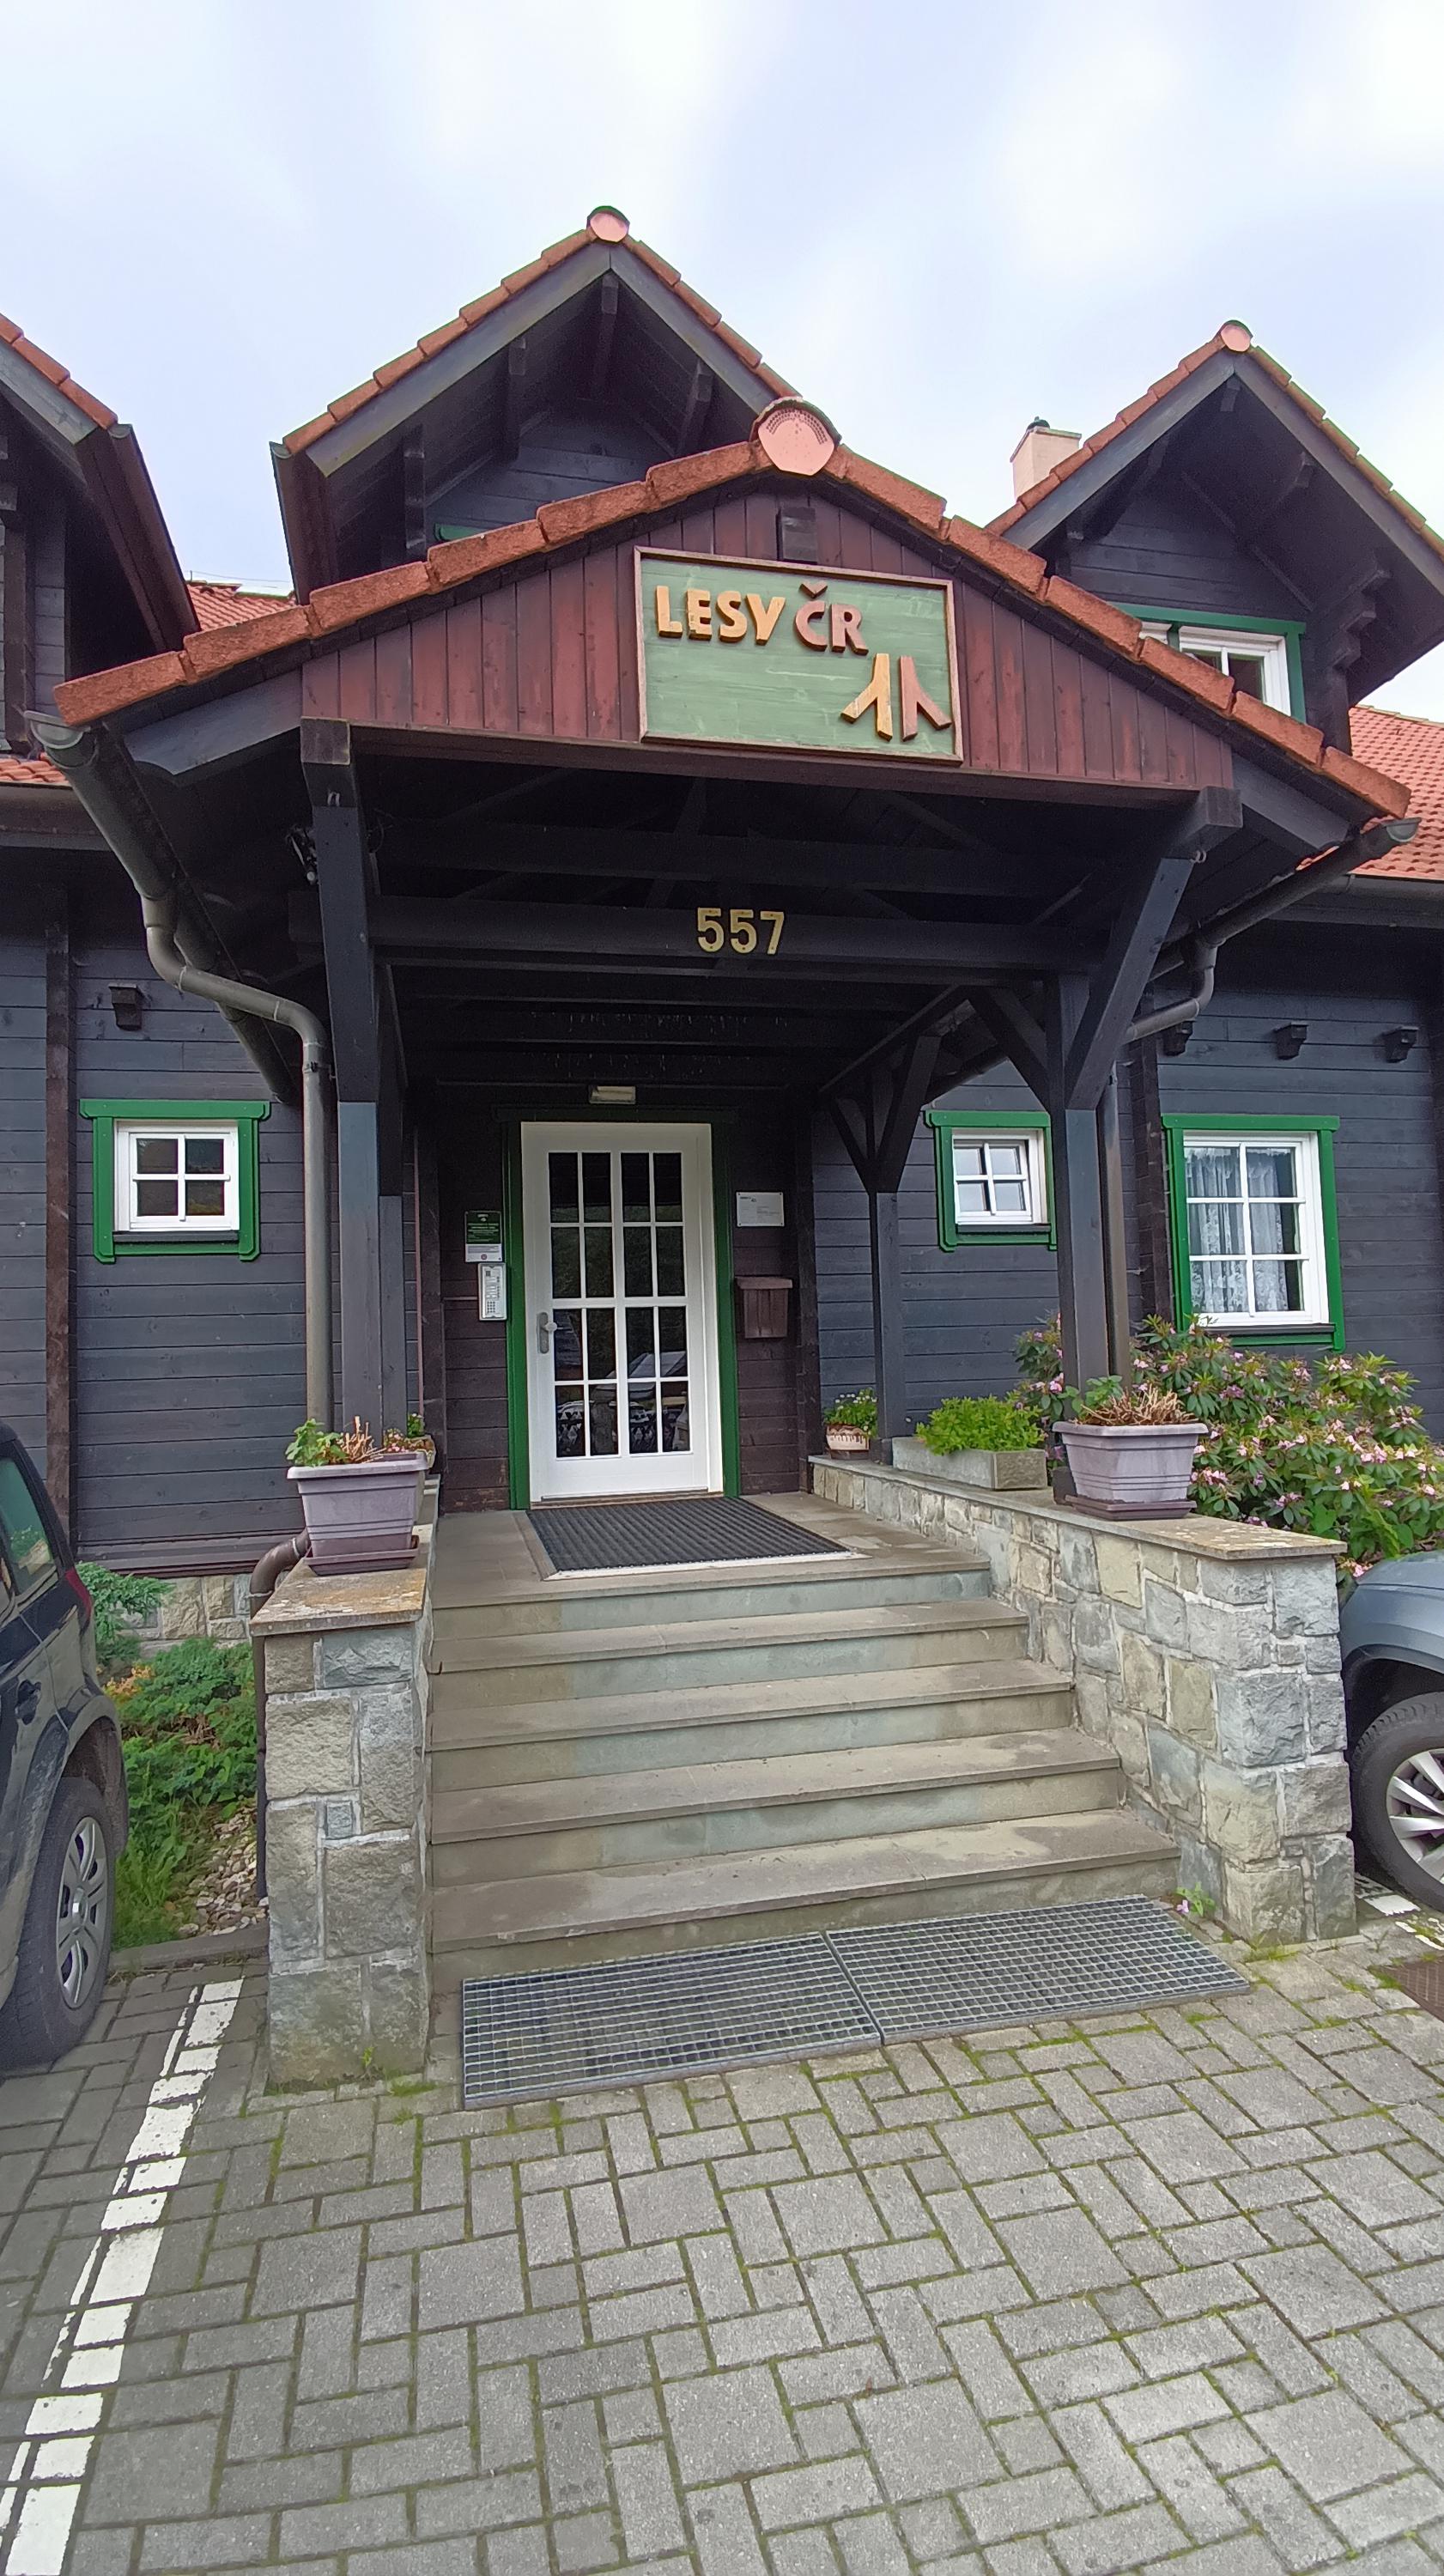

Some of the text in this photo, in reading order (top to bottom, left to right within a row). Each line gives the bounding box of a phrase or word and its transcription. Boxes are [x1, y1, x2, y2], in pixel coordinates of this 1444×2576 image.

[655, 580, 869, 655] LESY ČR
[697, 907, 785, 955] 557
